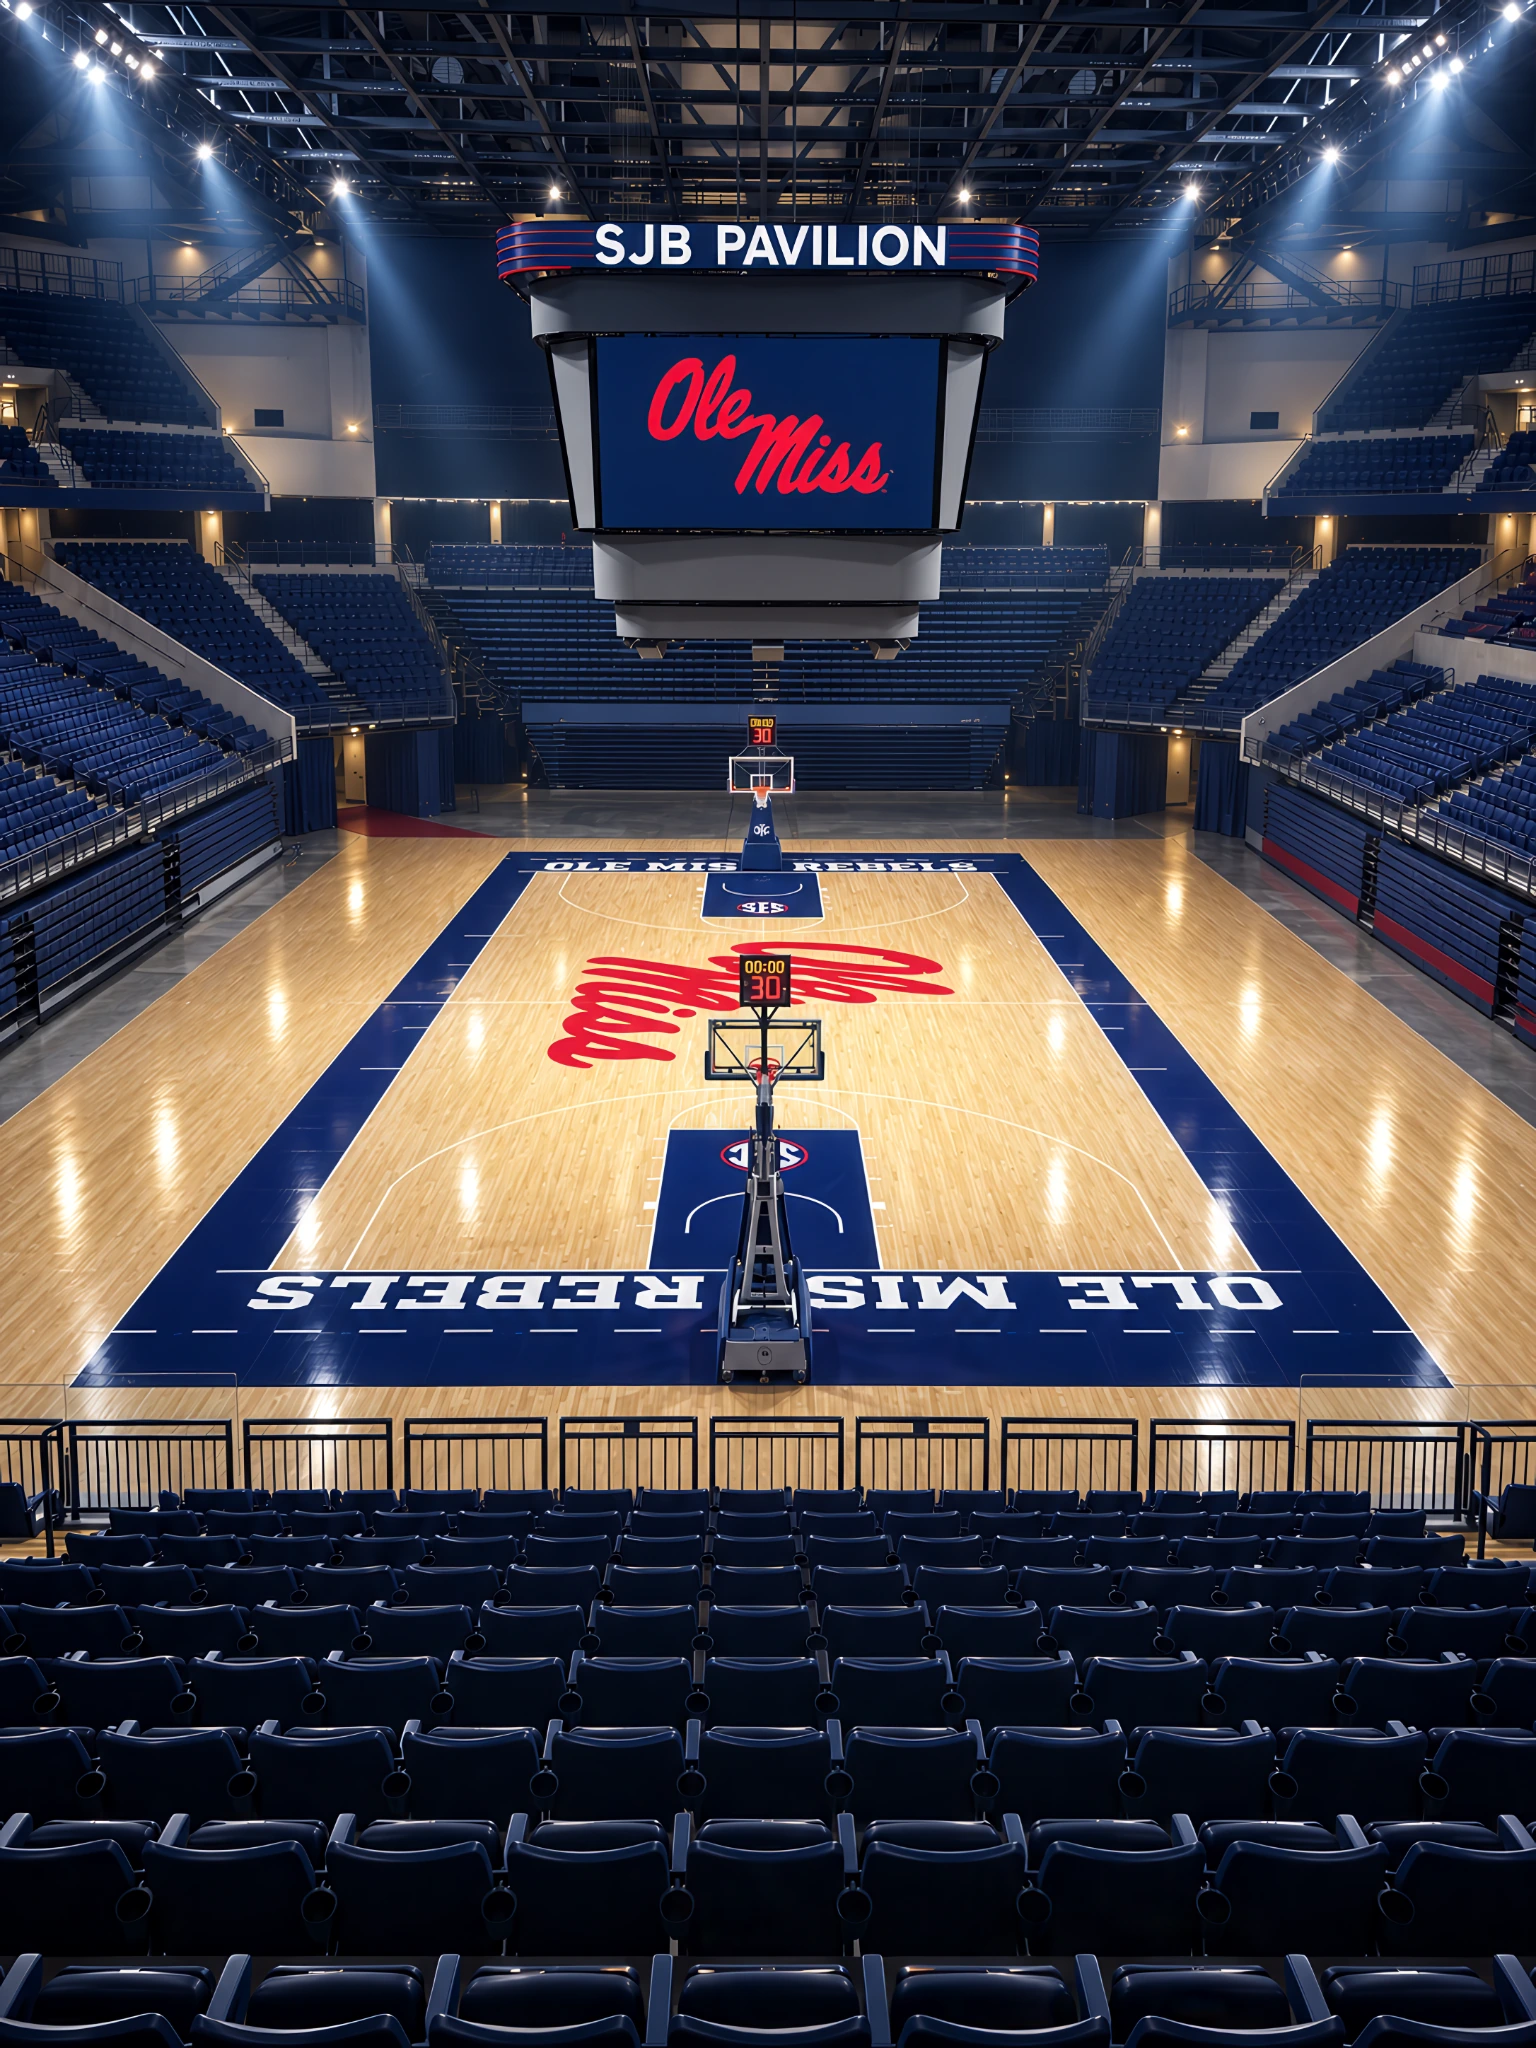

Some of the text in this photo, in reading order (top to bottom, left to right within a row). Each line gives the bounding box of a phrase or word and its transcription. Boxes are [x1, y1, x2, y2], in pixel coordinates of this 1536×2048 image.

[596, 223, 947, 267] SJB PAVILION
[647, 354, 755, 442] Ole
[735, 414, 889, 495] Miss
[752, 728, 772, 743] 30
[543, 861, 632, 872] OLE
[646, 861, 738, 872] MIS
[745, 960, 785, 974] 00:00
[750, 975, 781, 1000] 30
[246, 1275, 1283, 1311] OLE MIS REBELS
